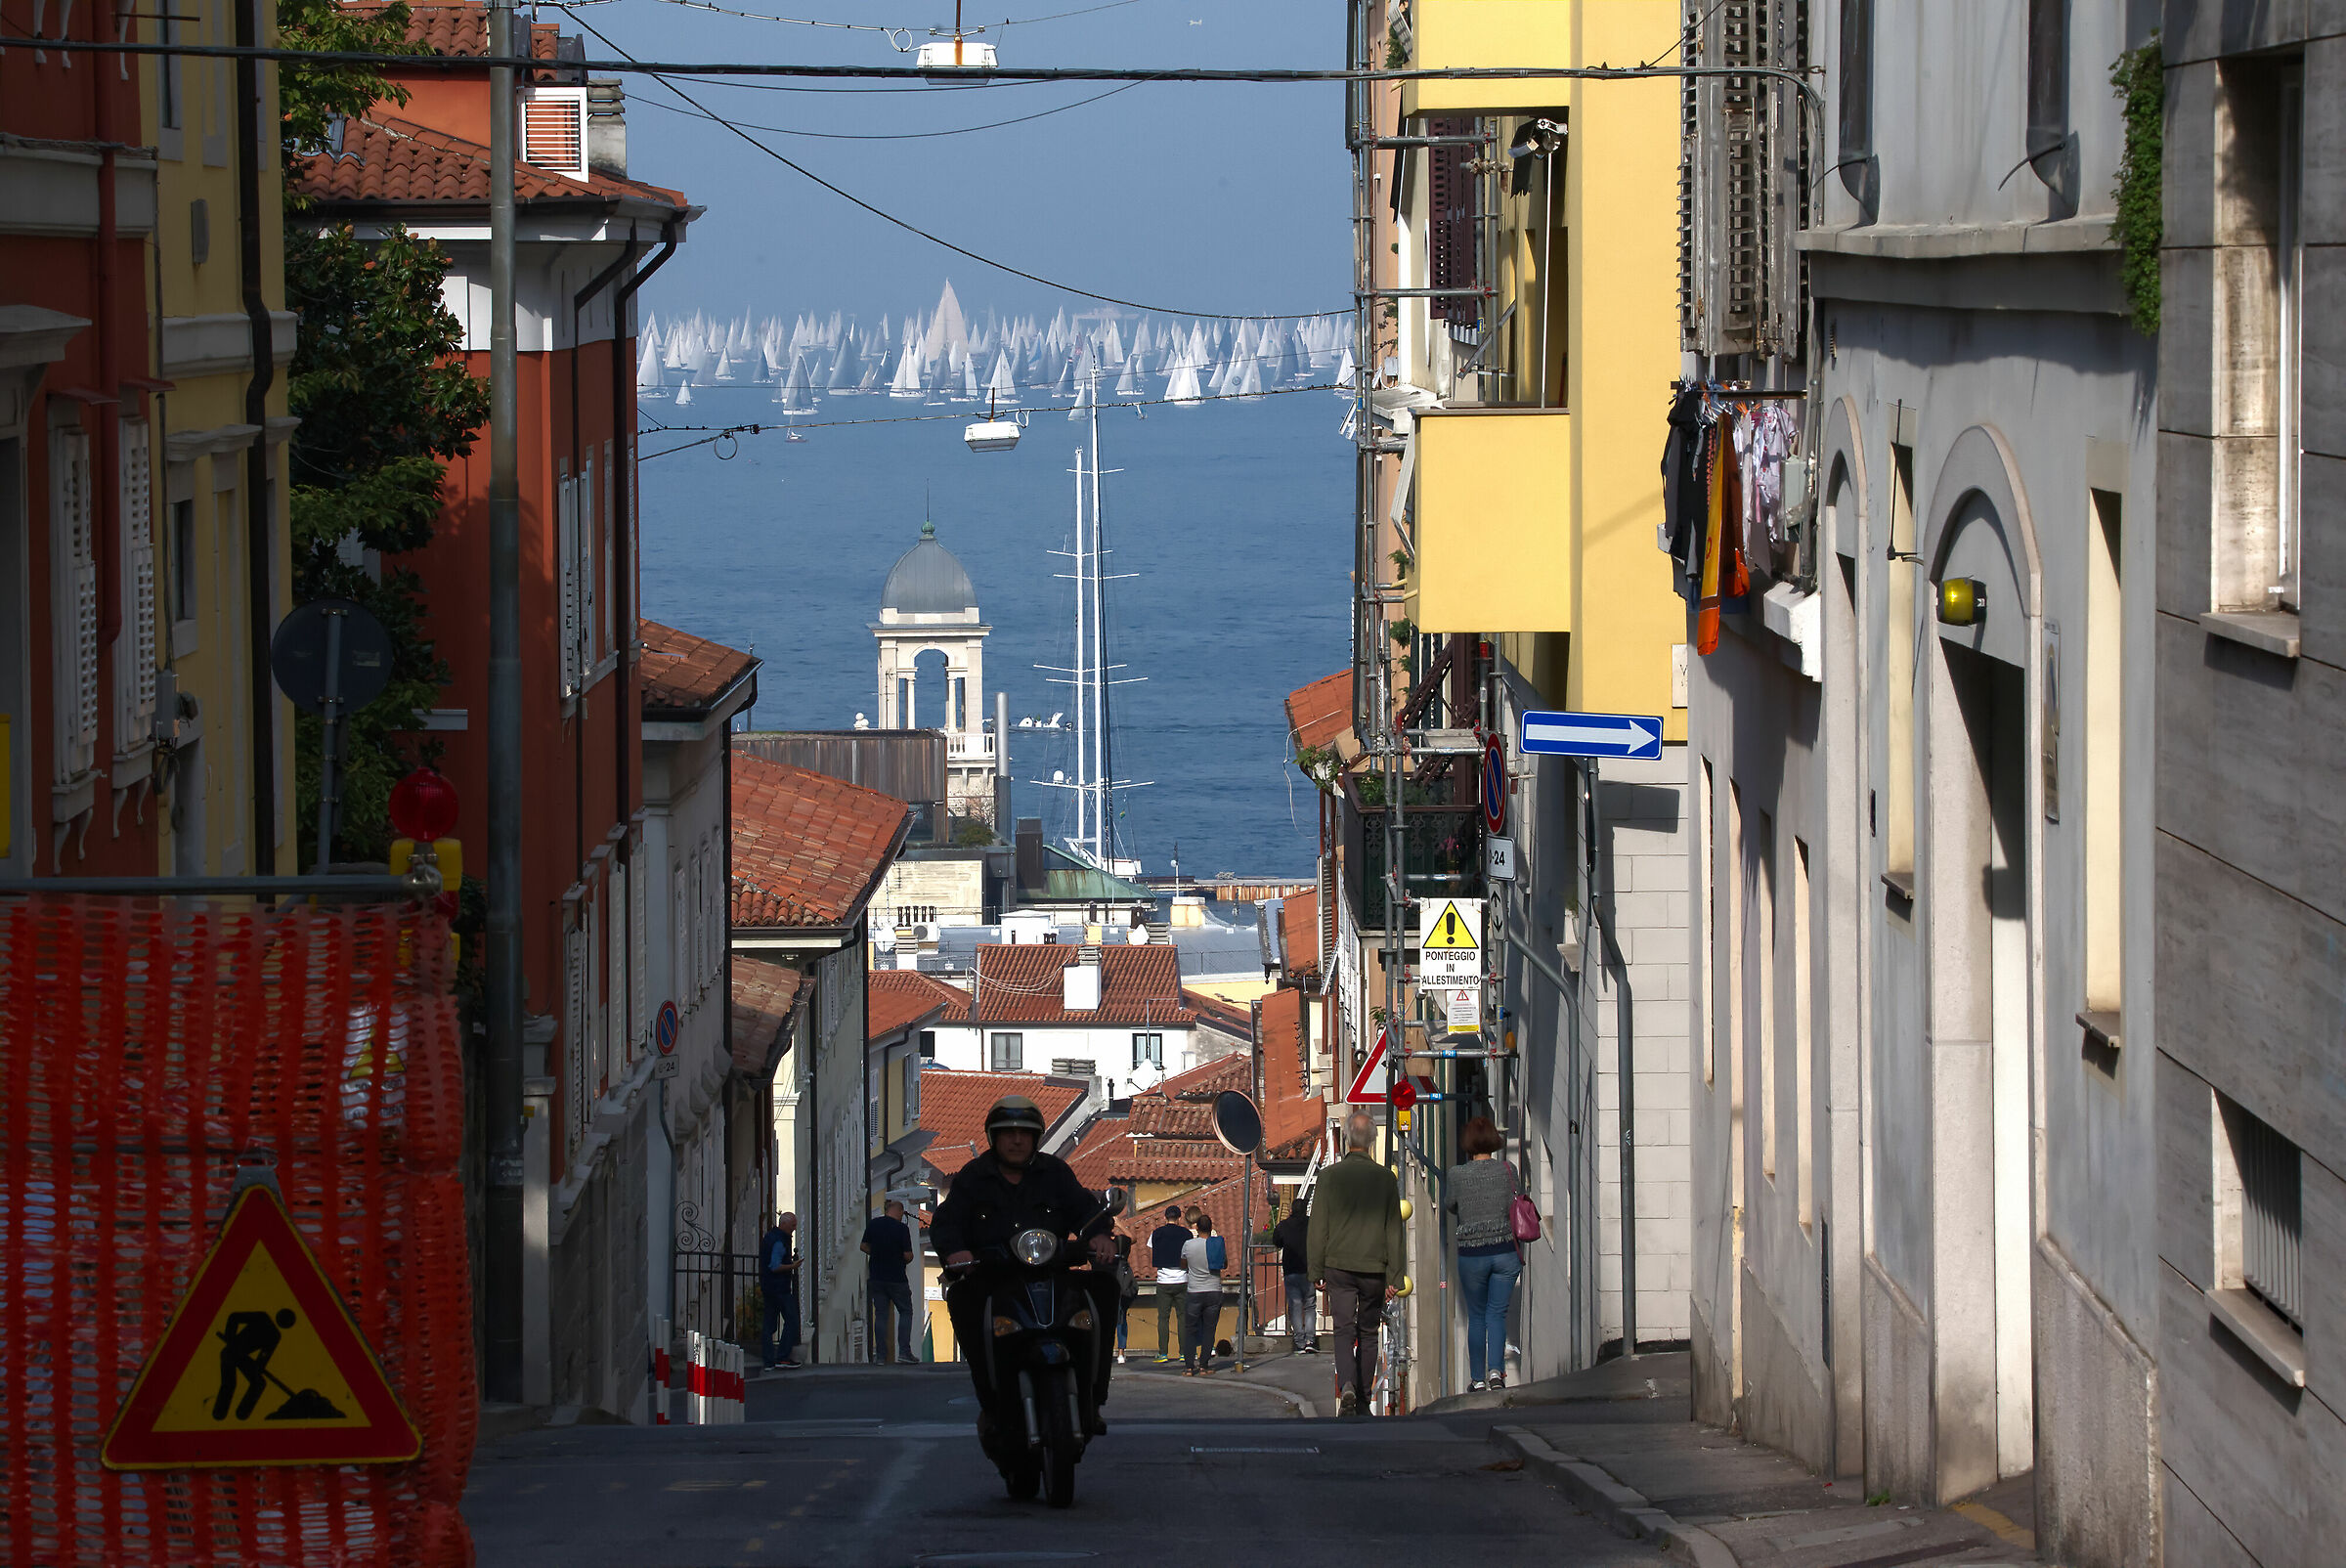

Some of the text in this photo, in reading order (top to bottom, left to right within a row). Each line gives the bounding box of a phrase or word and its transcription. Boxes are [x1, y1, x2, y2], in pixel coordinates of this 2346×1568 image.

[1425, 951, 1476, 961] PONTEGGIO
[1446, 963, 1455, 973] IN
[1422, 975, 1479, 985] ALLESTIMENTO
